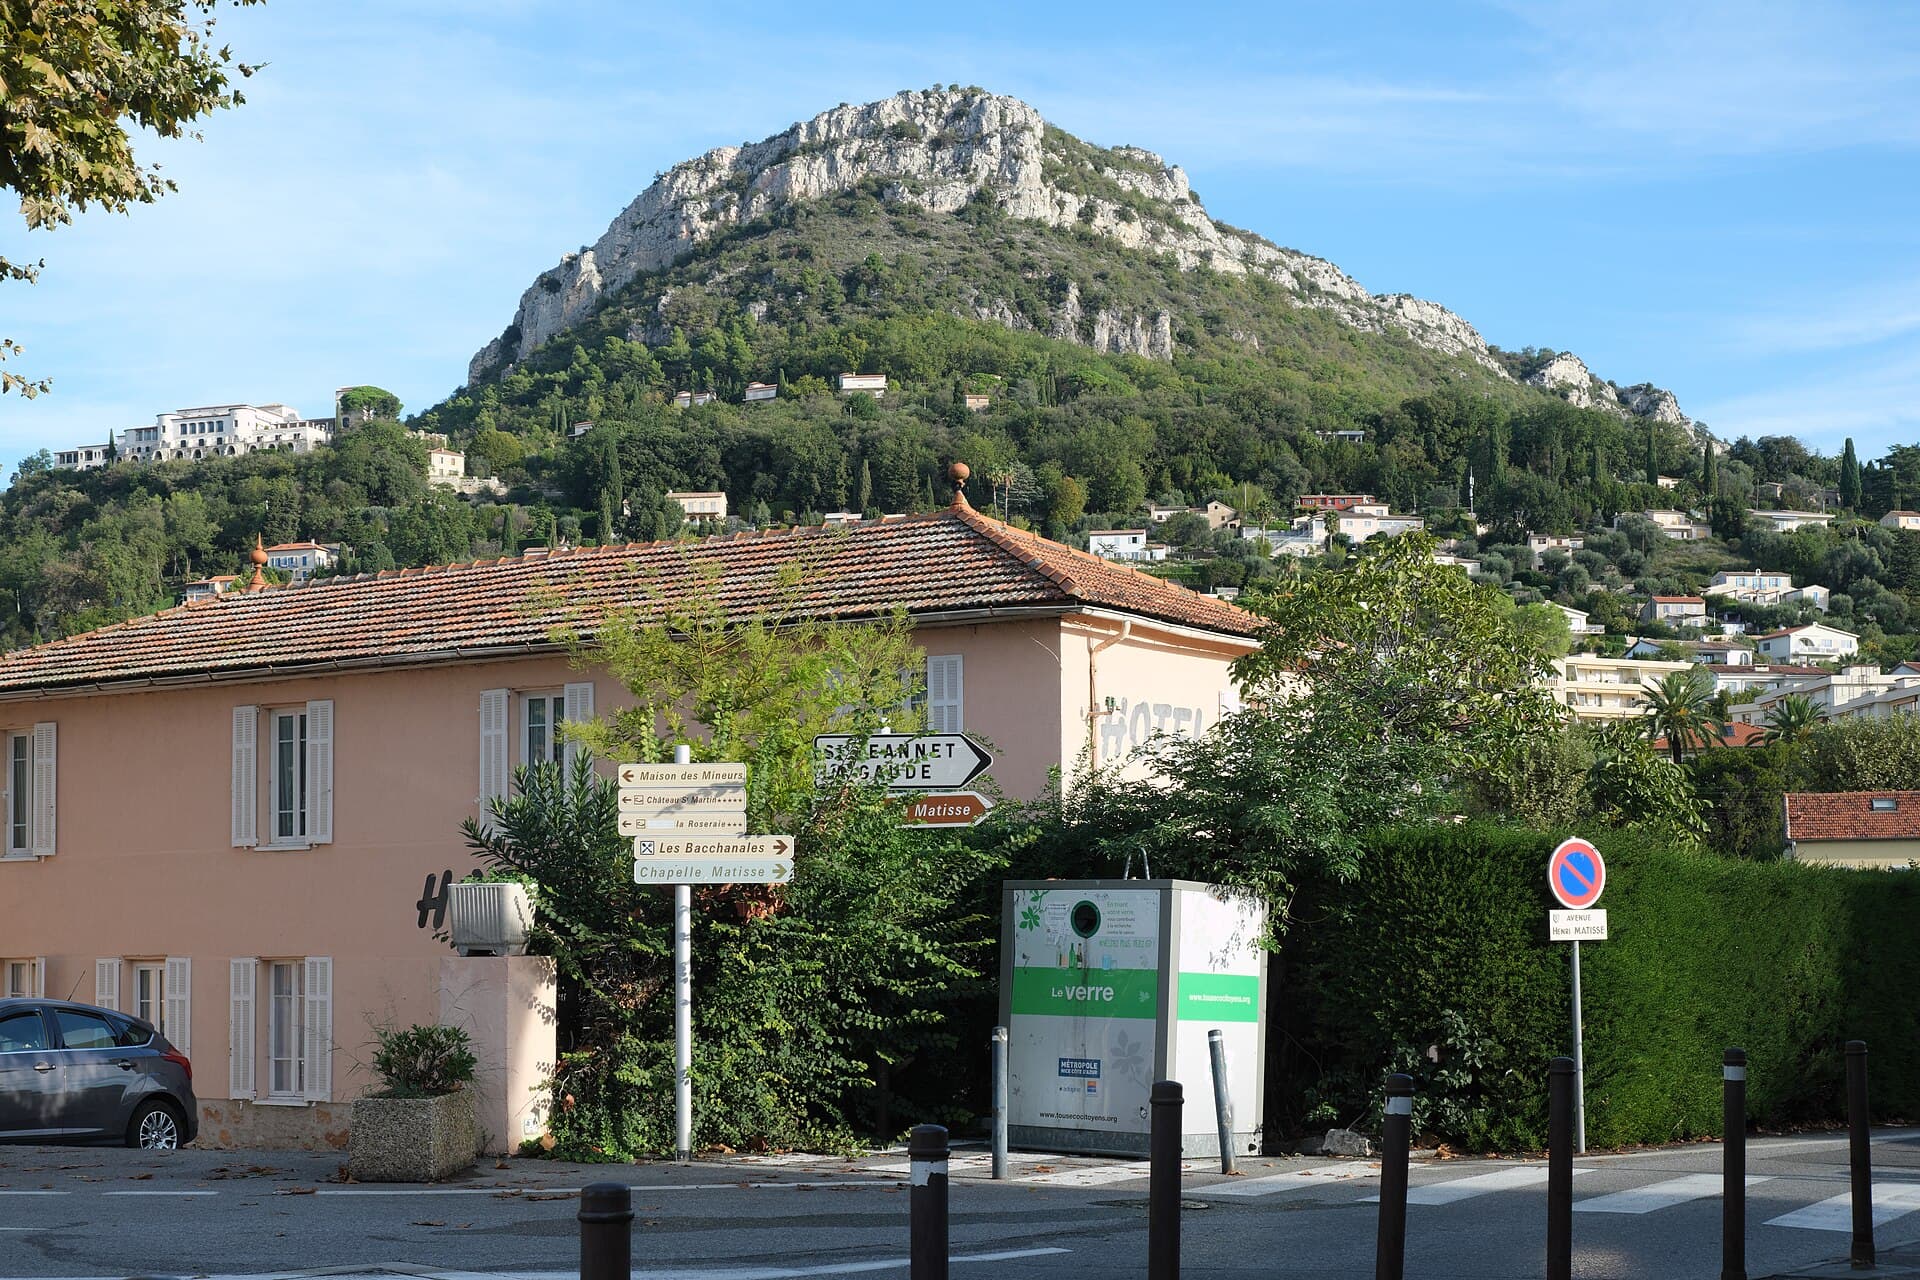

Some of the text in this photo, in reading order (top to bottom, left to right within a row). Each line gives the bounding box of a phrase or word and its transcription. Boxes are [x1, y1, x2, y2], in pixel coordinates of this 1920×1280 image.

[640, 770, 743, 781] Maison des Mineurs
[646, 796, 679, 804] Château
[690, 796, 717, 804] Martin
[914, 804, 971, 817] Matisse
[676, 819, 726, 828] la Roseraie
[659, 841, 765, 854] Les Bacchanales
[640, 865, 765, 880] Chapelle Matisse
[1574, 926, 1605, 935] MATISSE
[1051, 985, 1114, 1002] Le verre
[1040, 1112, 1118, 1123] www.tousecocitoyens.org
